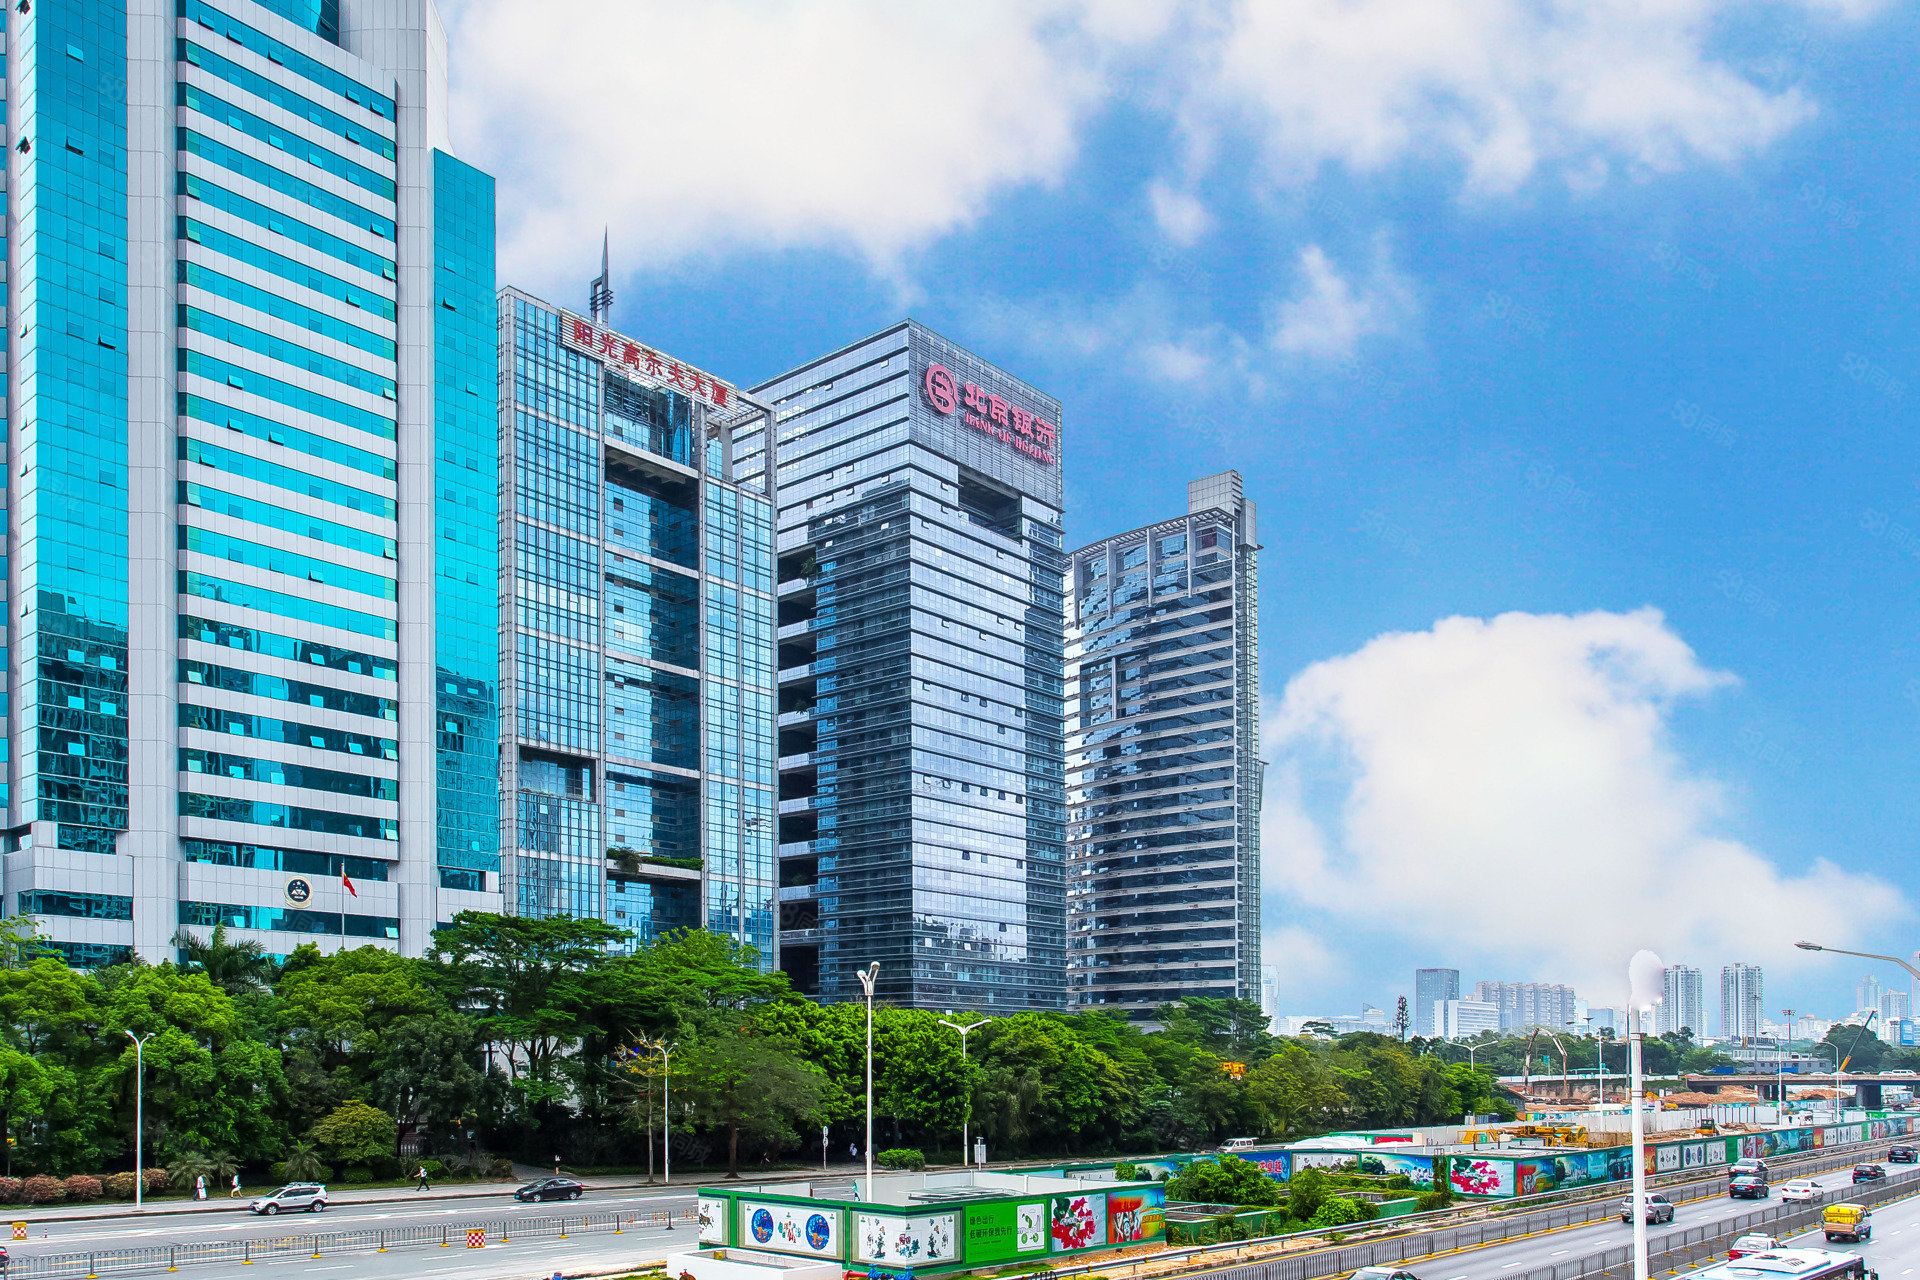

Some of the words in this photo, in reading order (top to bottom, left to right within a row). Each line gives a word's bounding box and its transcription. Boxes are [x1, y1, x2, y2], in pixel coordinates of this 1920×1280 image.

[573, 319, 728, 408] 阳光高尔夫大厦
[964, 382, 1056, 449] 北京银行
[965, 411, 995, 436] BANK
